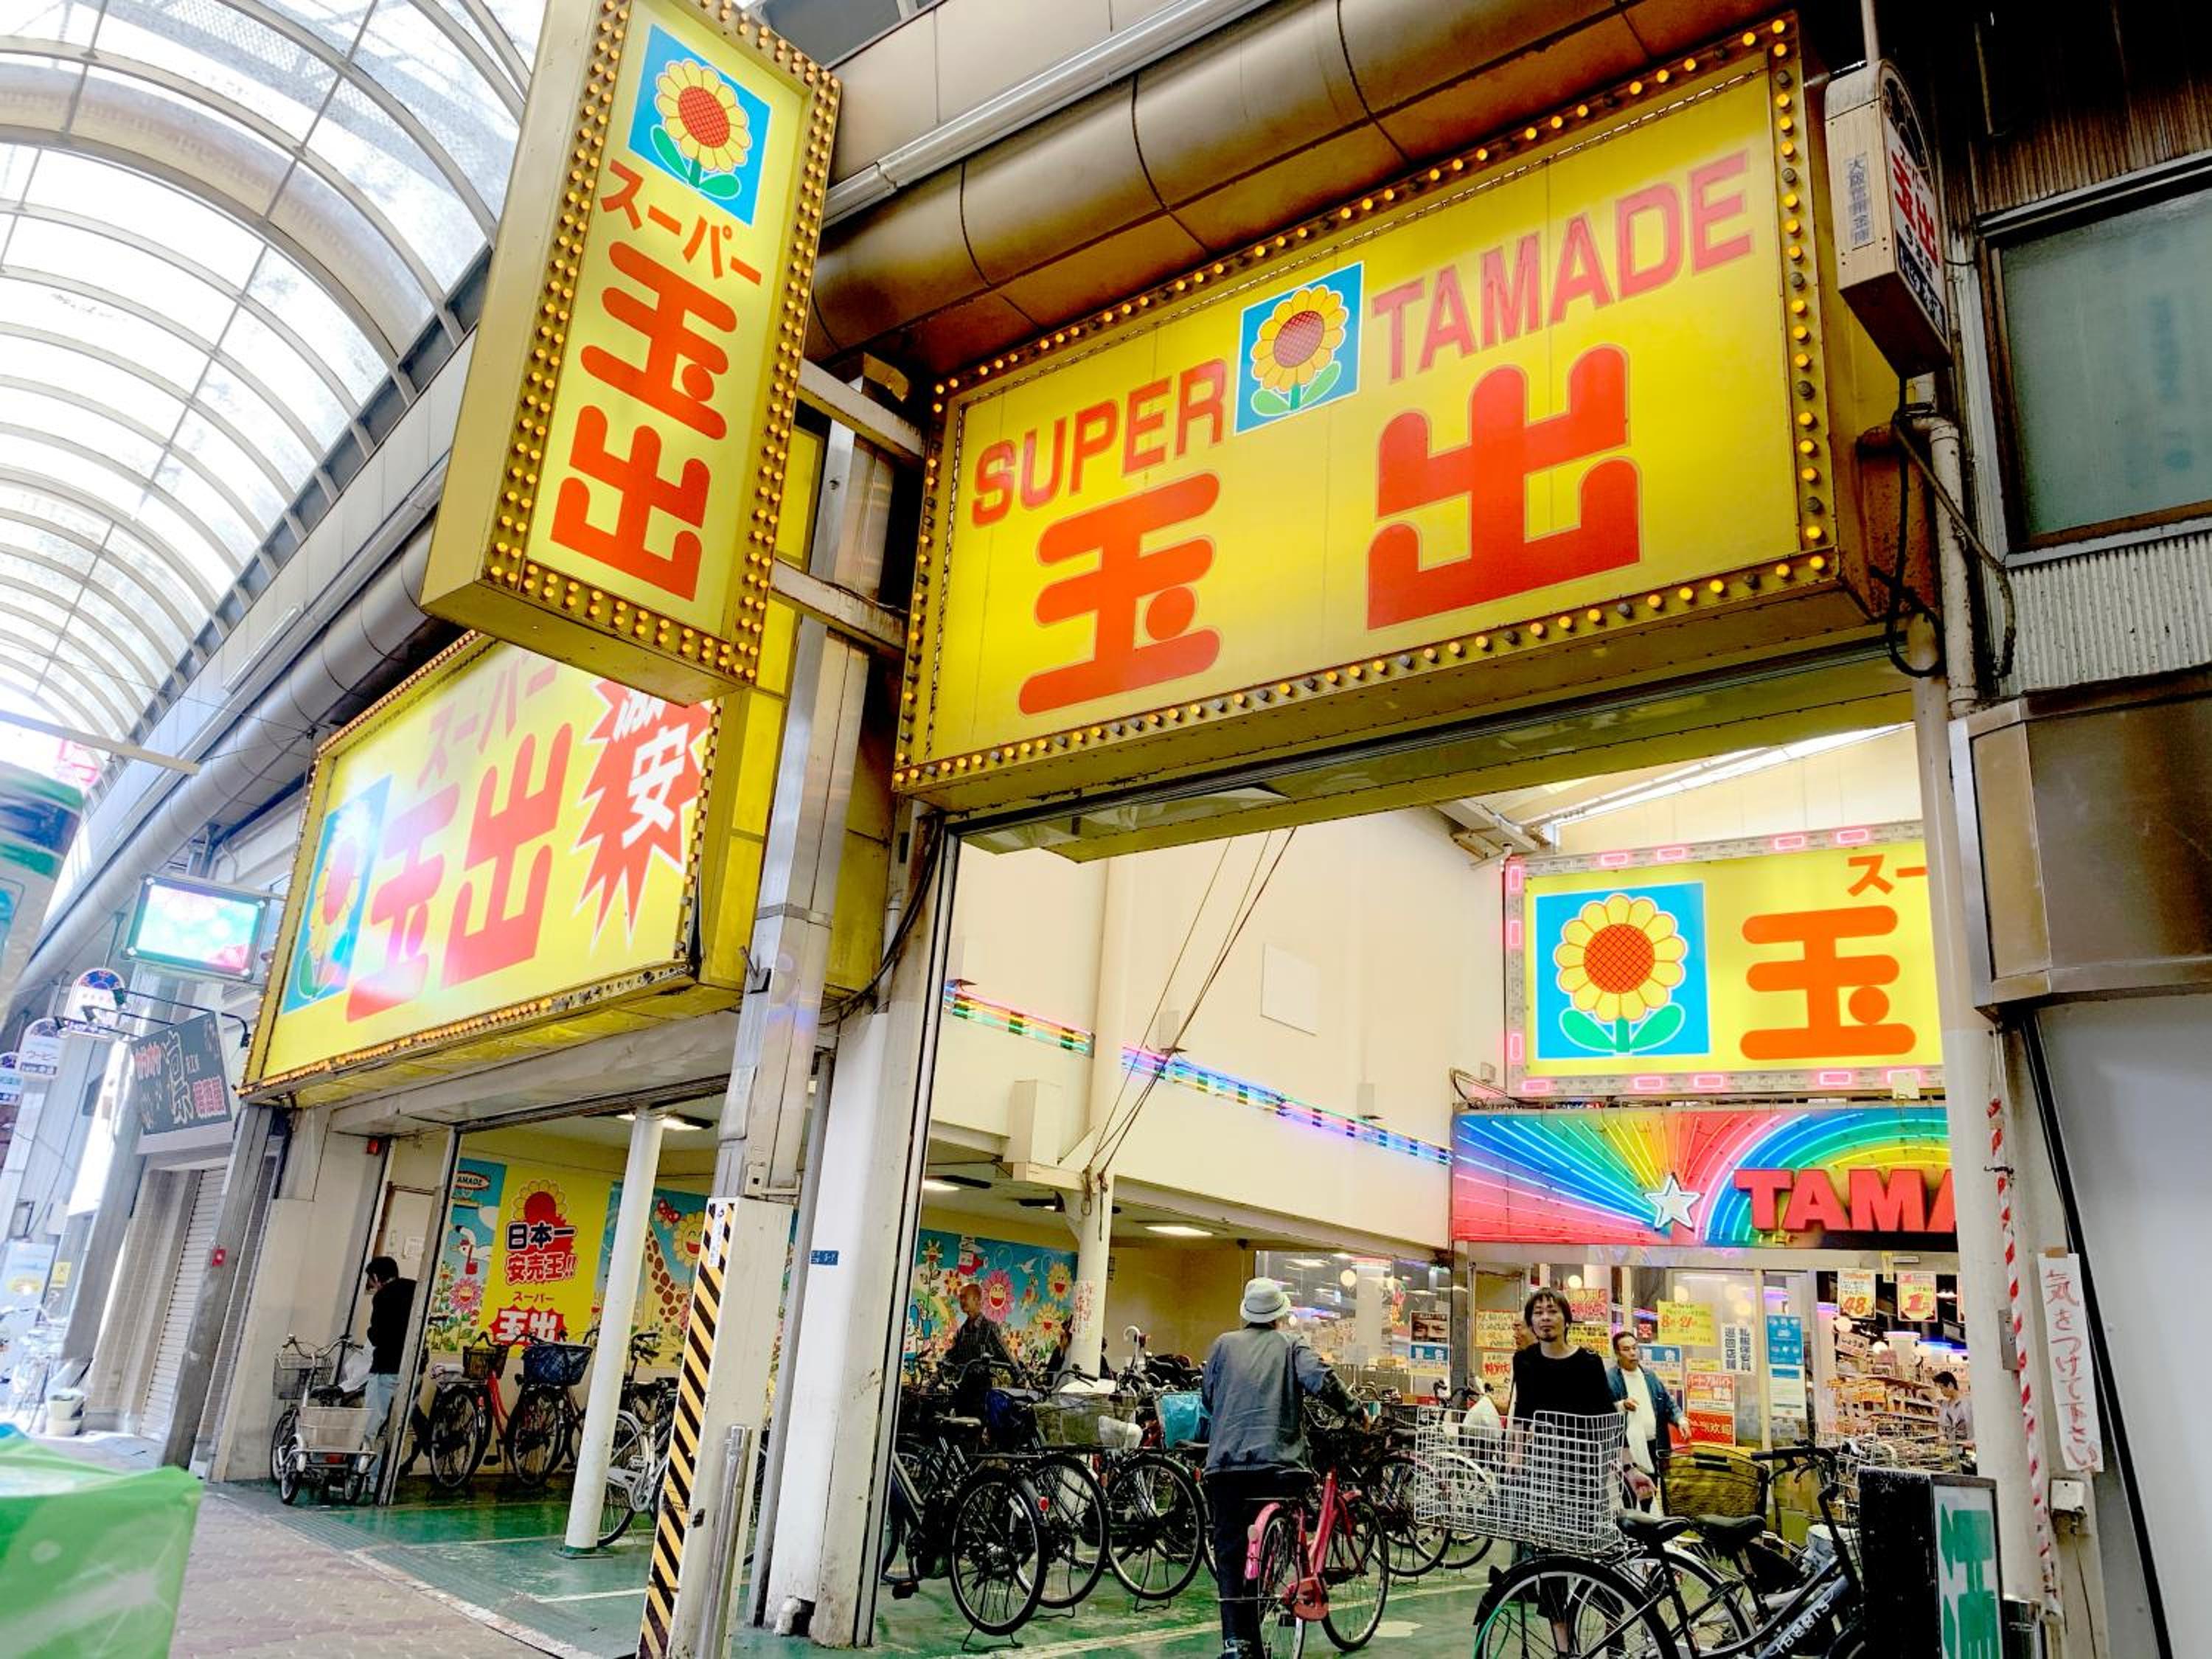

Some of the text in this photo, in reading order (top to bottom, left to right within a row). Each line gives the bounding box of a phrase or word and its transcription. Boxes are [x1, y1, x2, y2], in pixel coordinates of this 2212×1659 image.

[601, 159, 764, 286] スーパー
[1372, 150, 1754, 383] TAMADE
[1891, 150, 1939, 268] 玉出
[550, 241, 737, 602] 玉出
[971, 357, 1228, 529] SUPER
[1018, 344, 1641, 715] 玉出
[417, 652, 557, 790] スーパー
[347, 722, 573, 1022] 玉出
[1739, 905, 1916, 1061] 玉
[507, 1221, 577, 1251] 日本一
[512, 1291, 554, 1303] スーパー
[495, 1310, 558, 1343] 玉出
